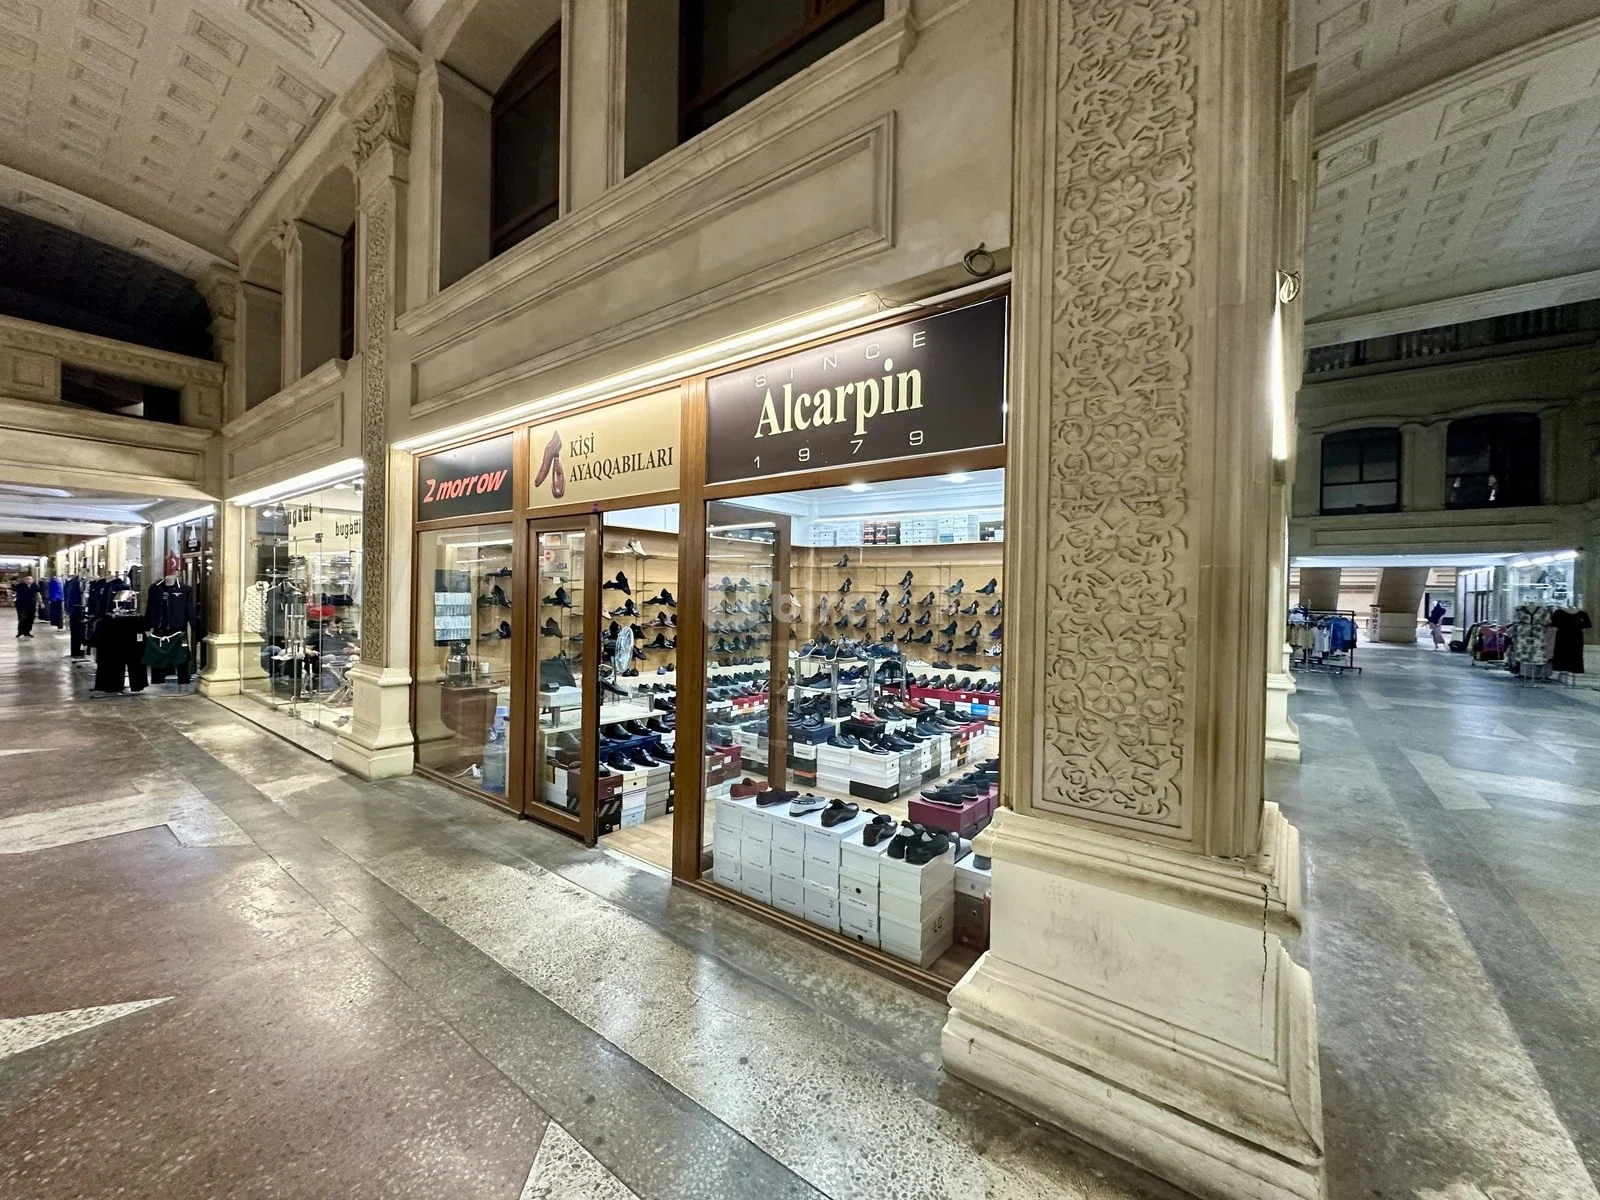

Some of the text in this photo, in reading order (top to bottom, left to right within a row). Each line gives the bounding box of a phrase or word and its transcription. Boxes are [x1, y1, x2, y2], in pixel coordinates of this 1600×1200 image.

[755, 331, 926, 388] SINCE
[754, 358, 923, 438] Alcarpin
[570, 432, 595, 460] KİŞİ
[753, 430, 924, 469] 1979
[569, 447, 674, 483] AYAQQABILARI
[423, 469, 508, 503] 2 morrow
[335, 518, 362, 539] bugatti
